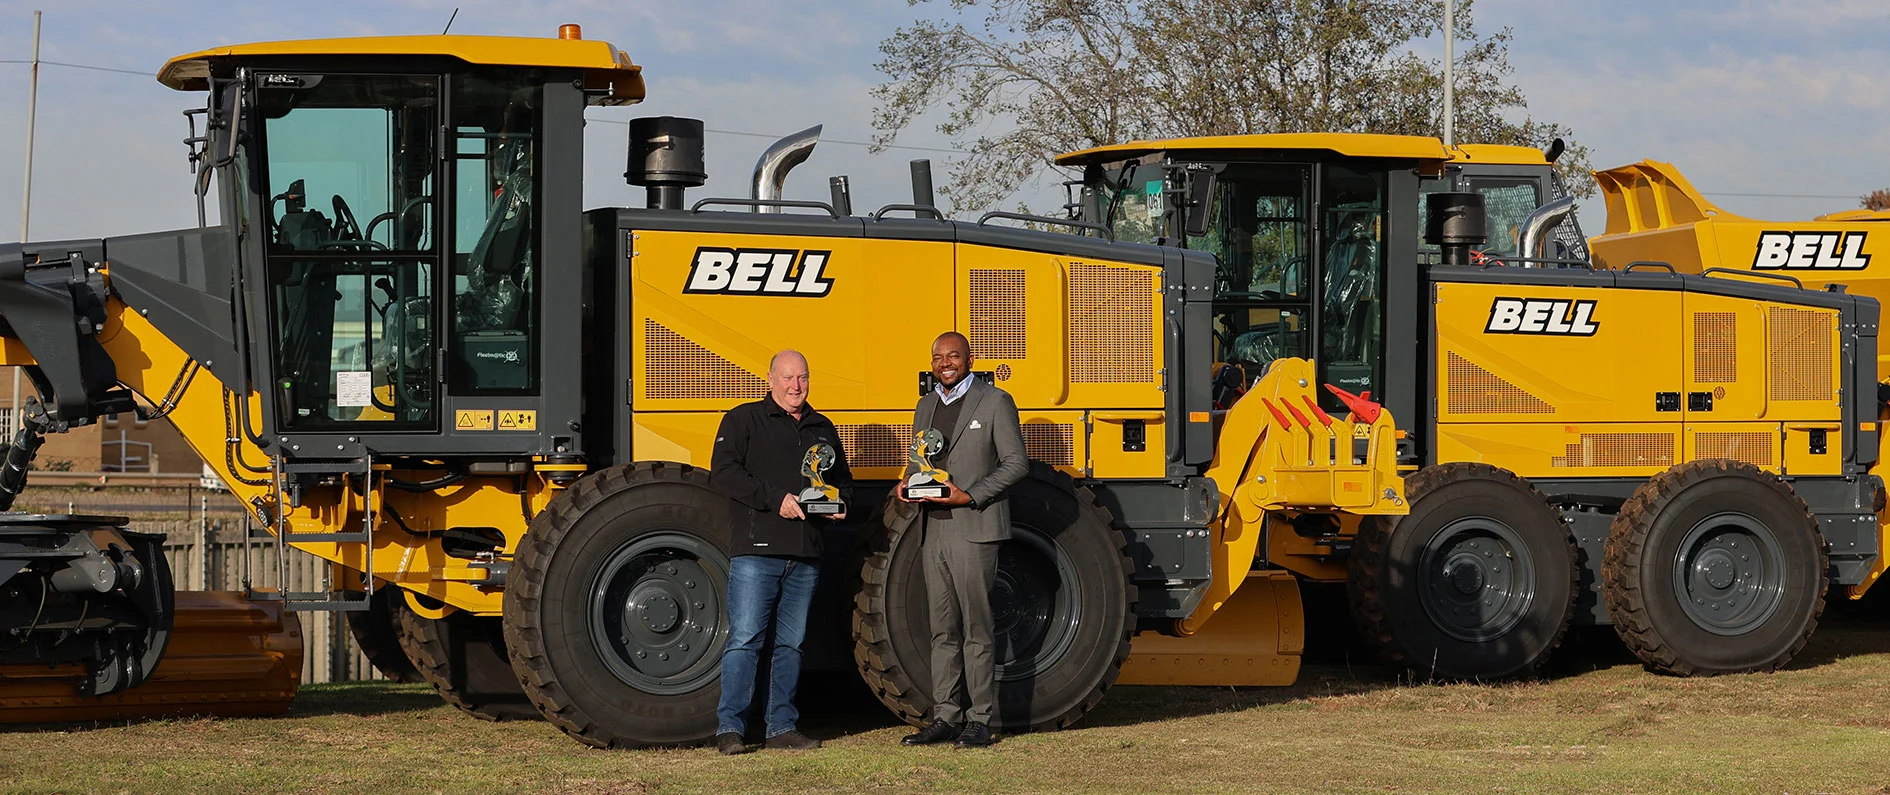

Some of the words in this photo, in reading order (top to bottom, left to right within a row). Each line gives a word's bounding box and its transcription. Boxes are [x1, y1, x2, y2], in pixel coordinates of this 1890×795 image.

[1752, 231, 1872, 270] BELL
[683, 247, 834, 297] BELL
[1484, 297, 1600, 336] BELL
